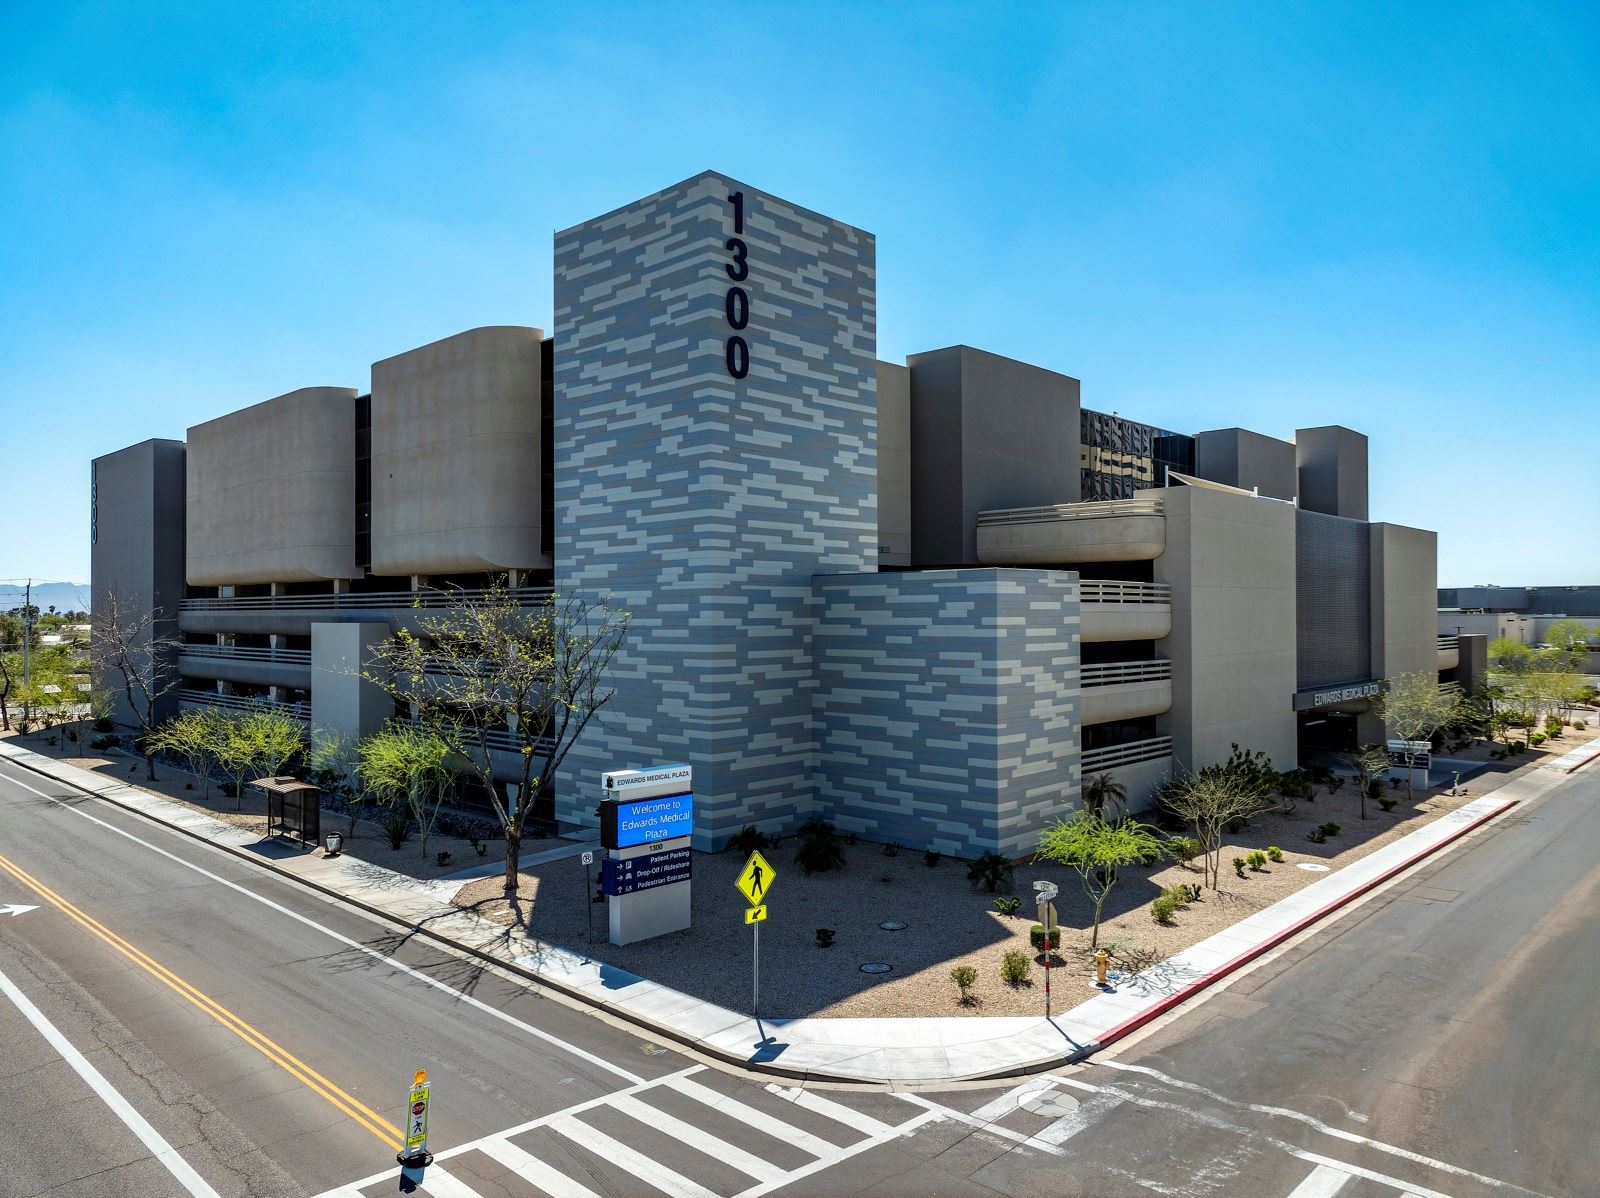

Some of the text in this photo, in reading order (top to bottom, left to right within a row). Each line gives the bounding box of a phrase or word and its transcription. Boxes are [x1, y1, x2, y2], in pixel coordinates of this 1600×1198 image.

[726, 191, 750, 379] 1300
[1314, 690, 1341, 706] EDWARDS
[1342, 686, 1363, 700] MEDICAL
[618, 776, 646, 786] EDWARDS
[646, 772, 670, 782] MEDICAL
[632, 804, 670, 815] Welcome
[622, 810, 690, 830] Edwards Medical
[645, 828, 668, 840] Plaza
[649, 844, 663, 852] 1300
[650, 850, 690, 863] Patient Parking
[636, 867, 660, 877] Drop-Off
[664, 862, 690, 872] Rideshare
[638, 872, 690, 888] Pedestrian Entrance
